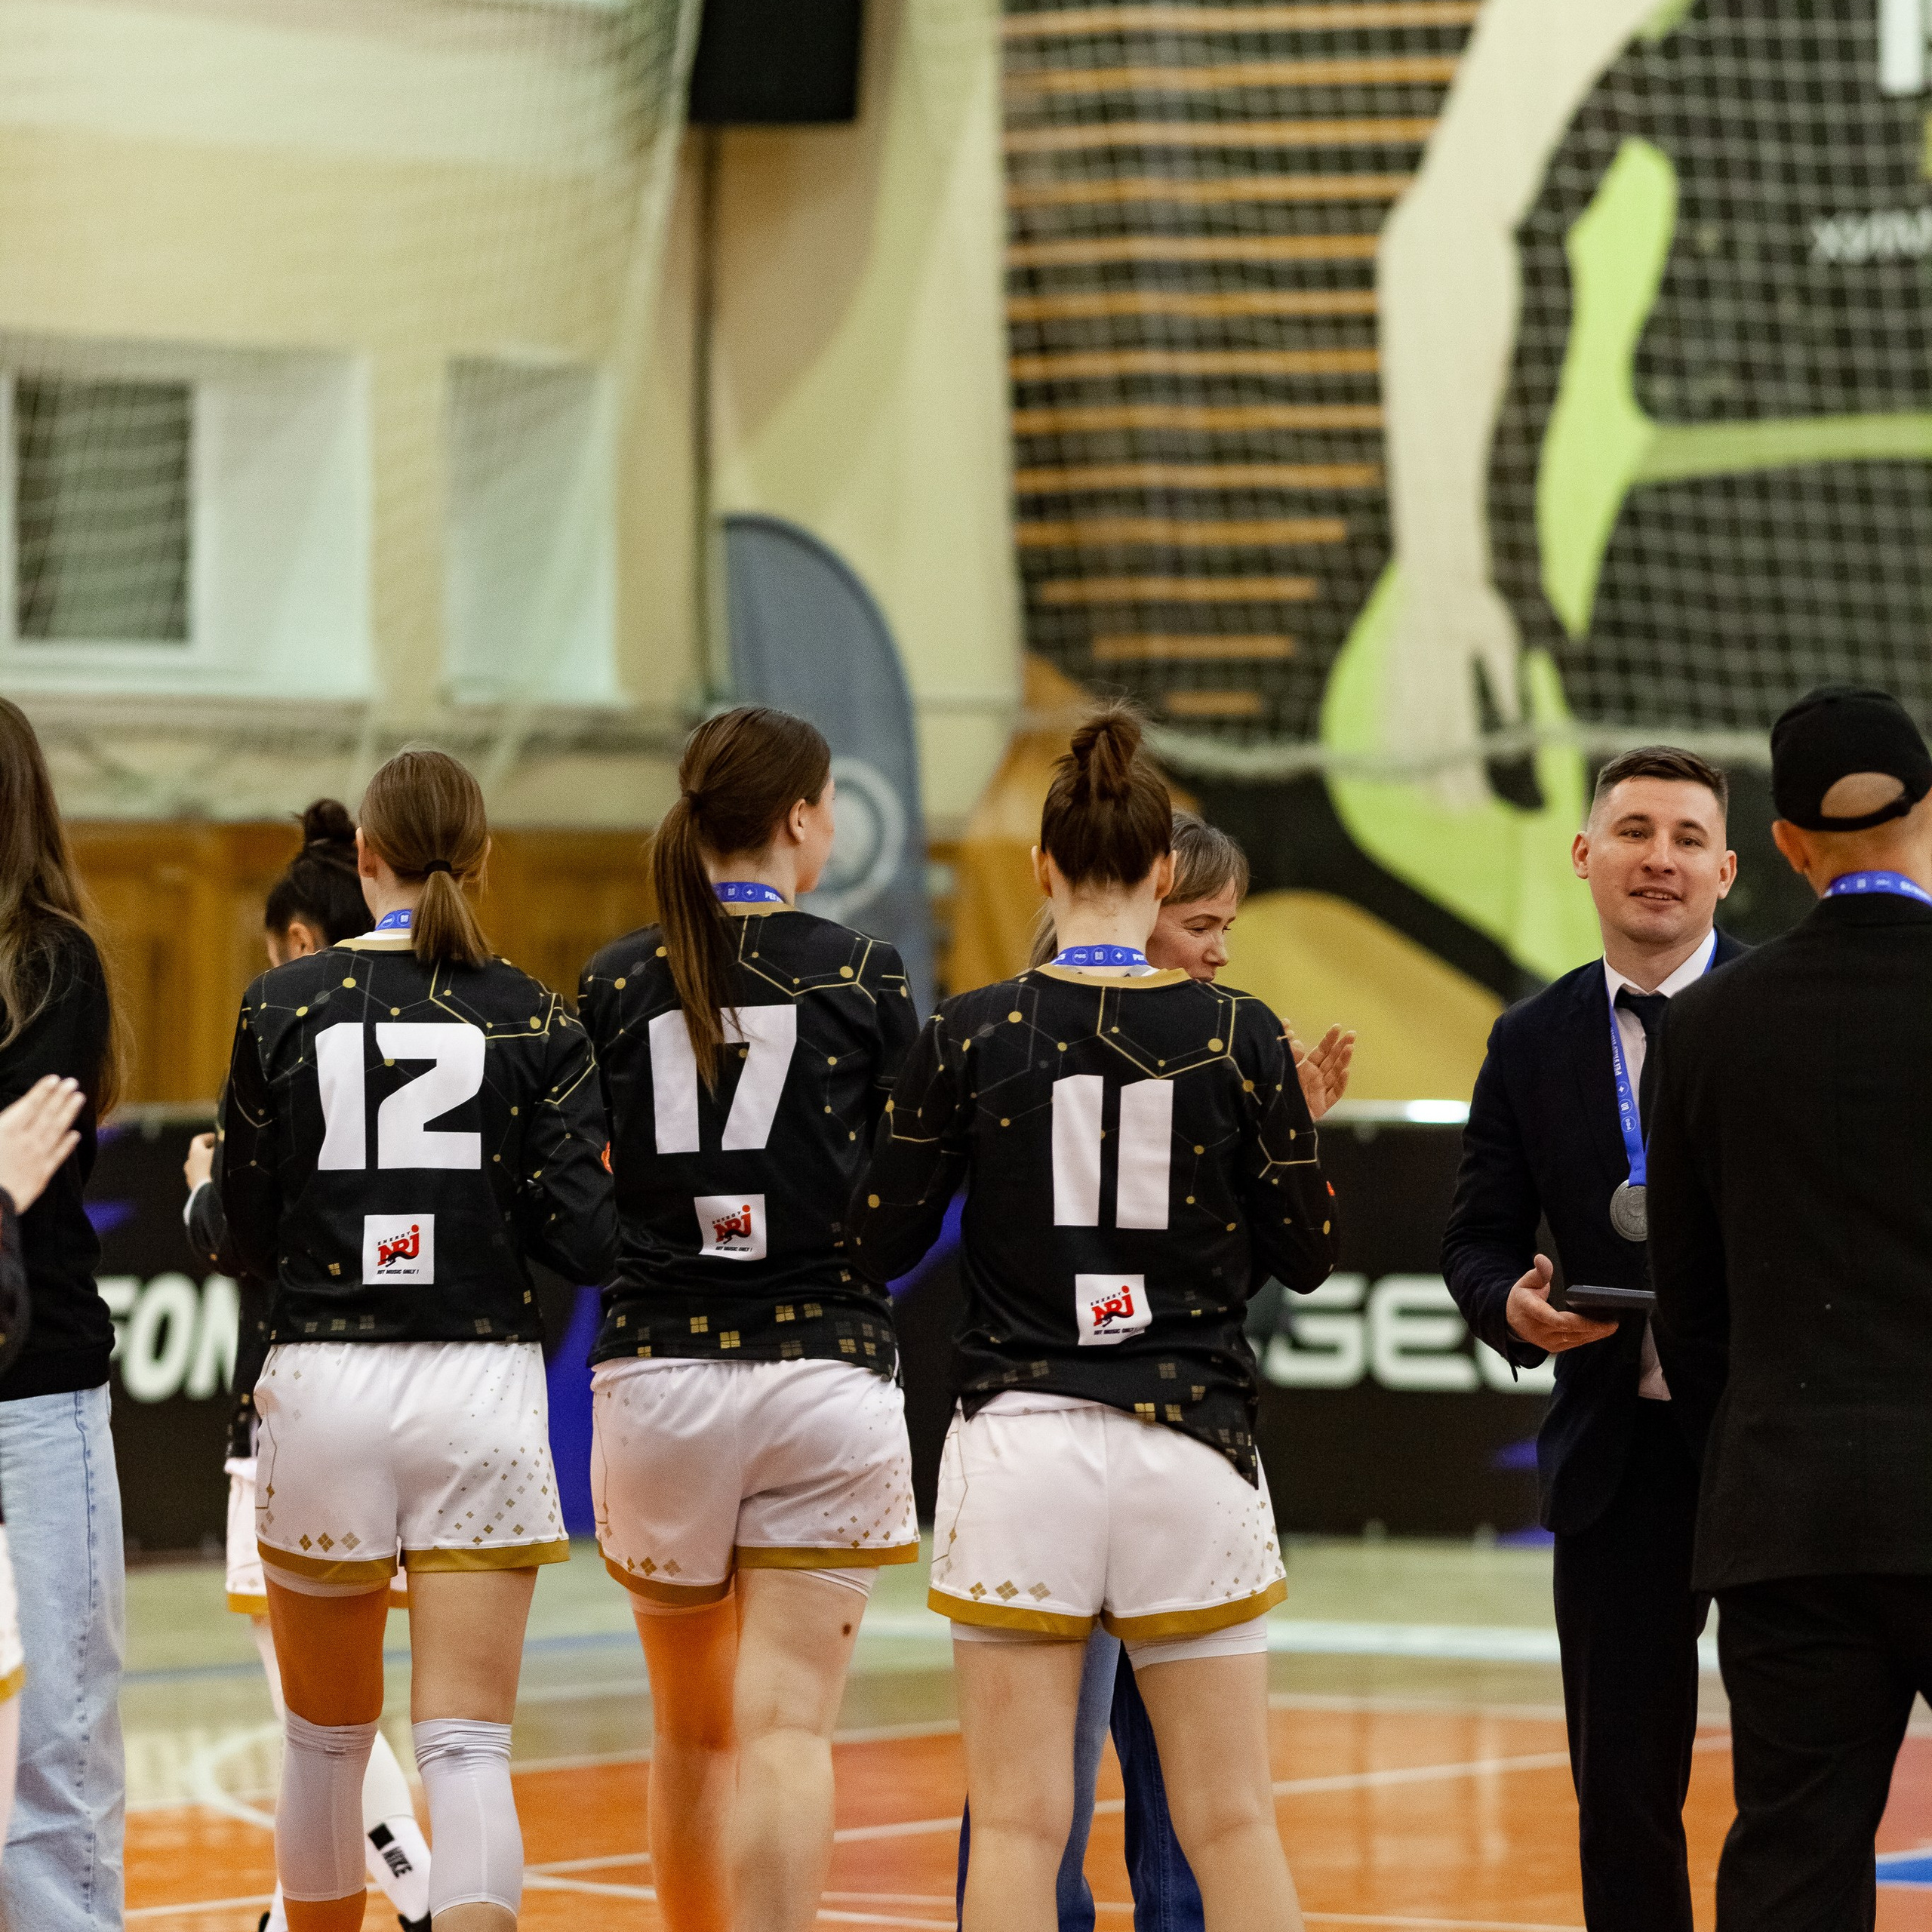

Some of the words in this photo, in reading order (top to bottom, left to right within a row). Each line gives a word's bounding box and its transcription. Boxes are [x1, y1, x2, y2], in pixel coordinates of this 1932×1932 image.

[315, 1022, 485, 1170] 12
[649, 1004, 797, 1154] 17
[1052, 1074, 1174, 1229] 11
[382, 1846, 413, 1878] NIKE
